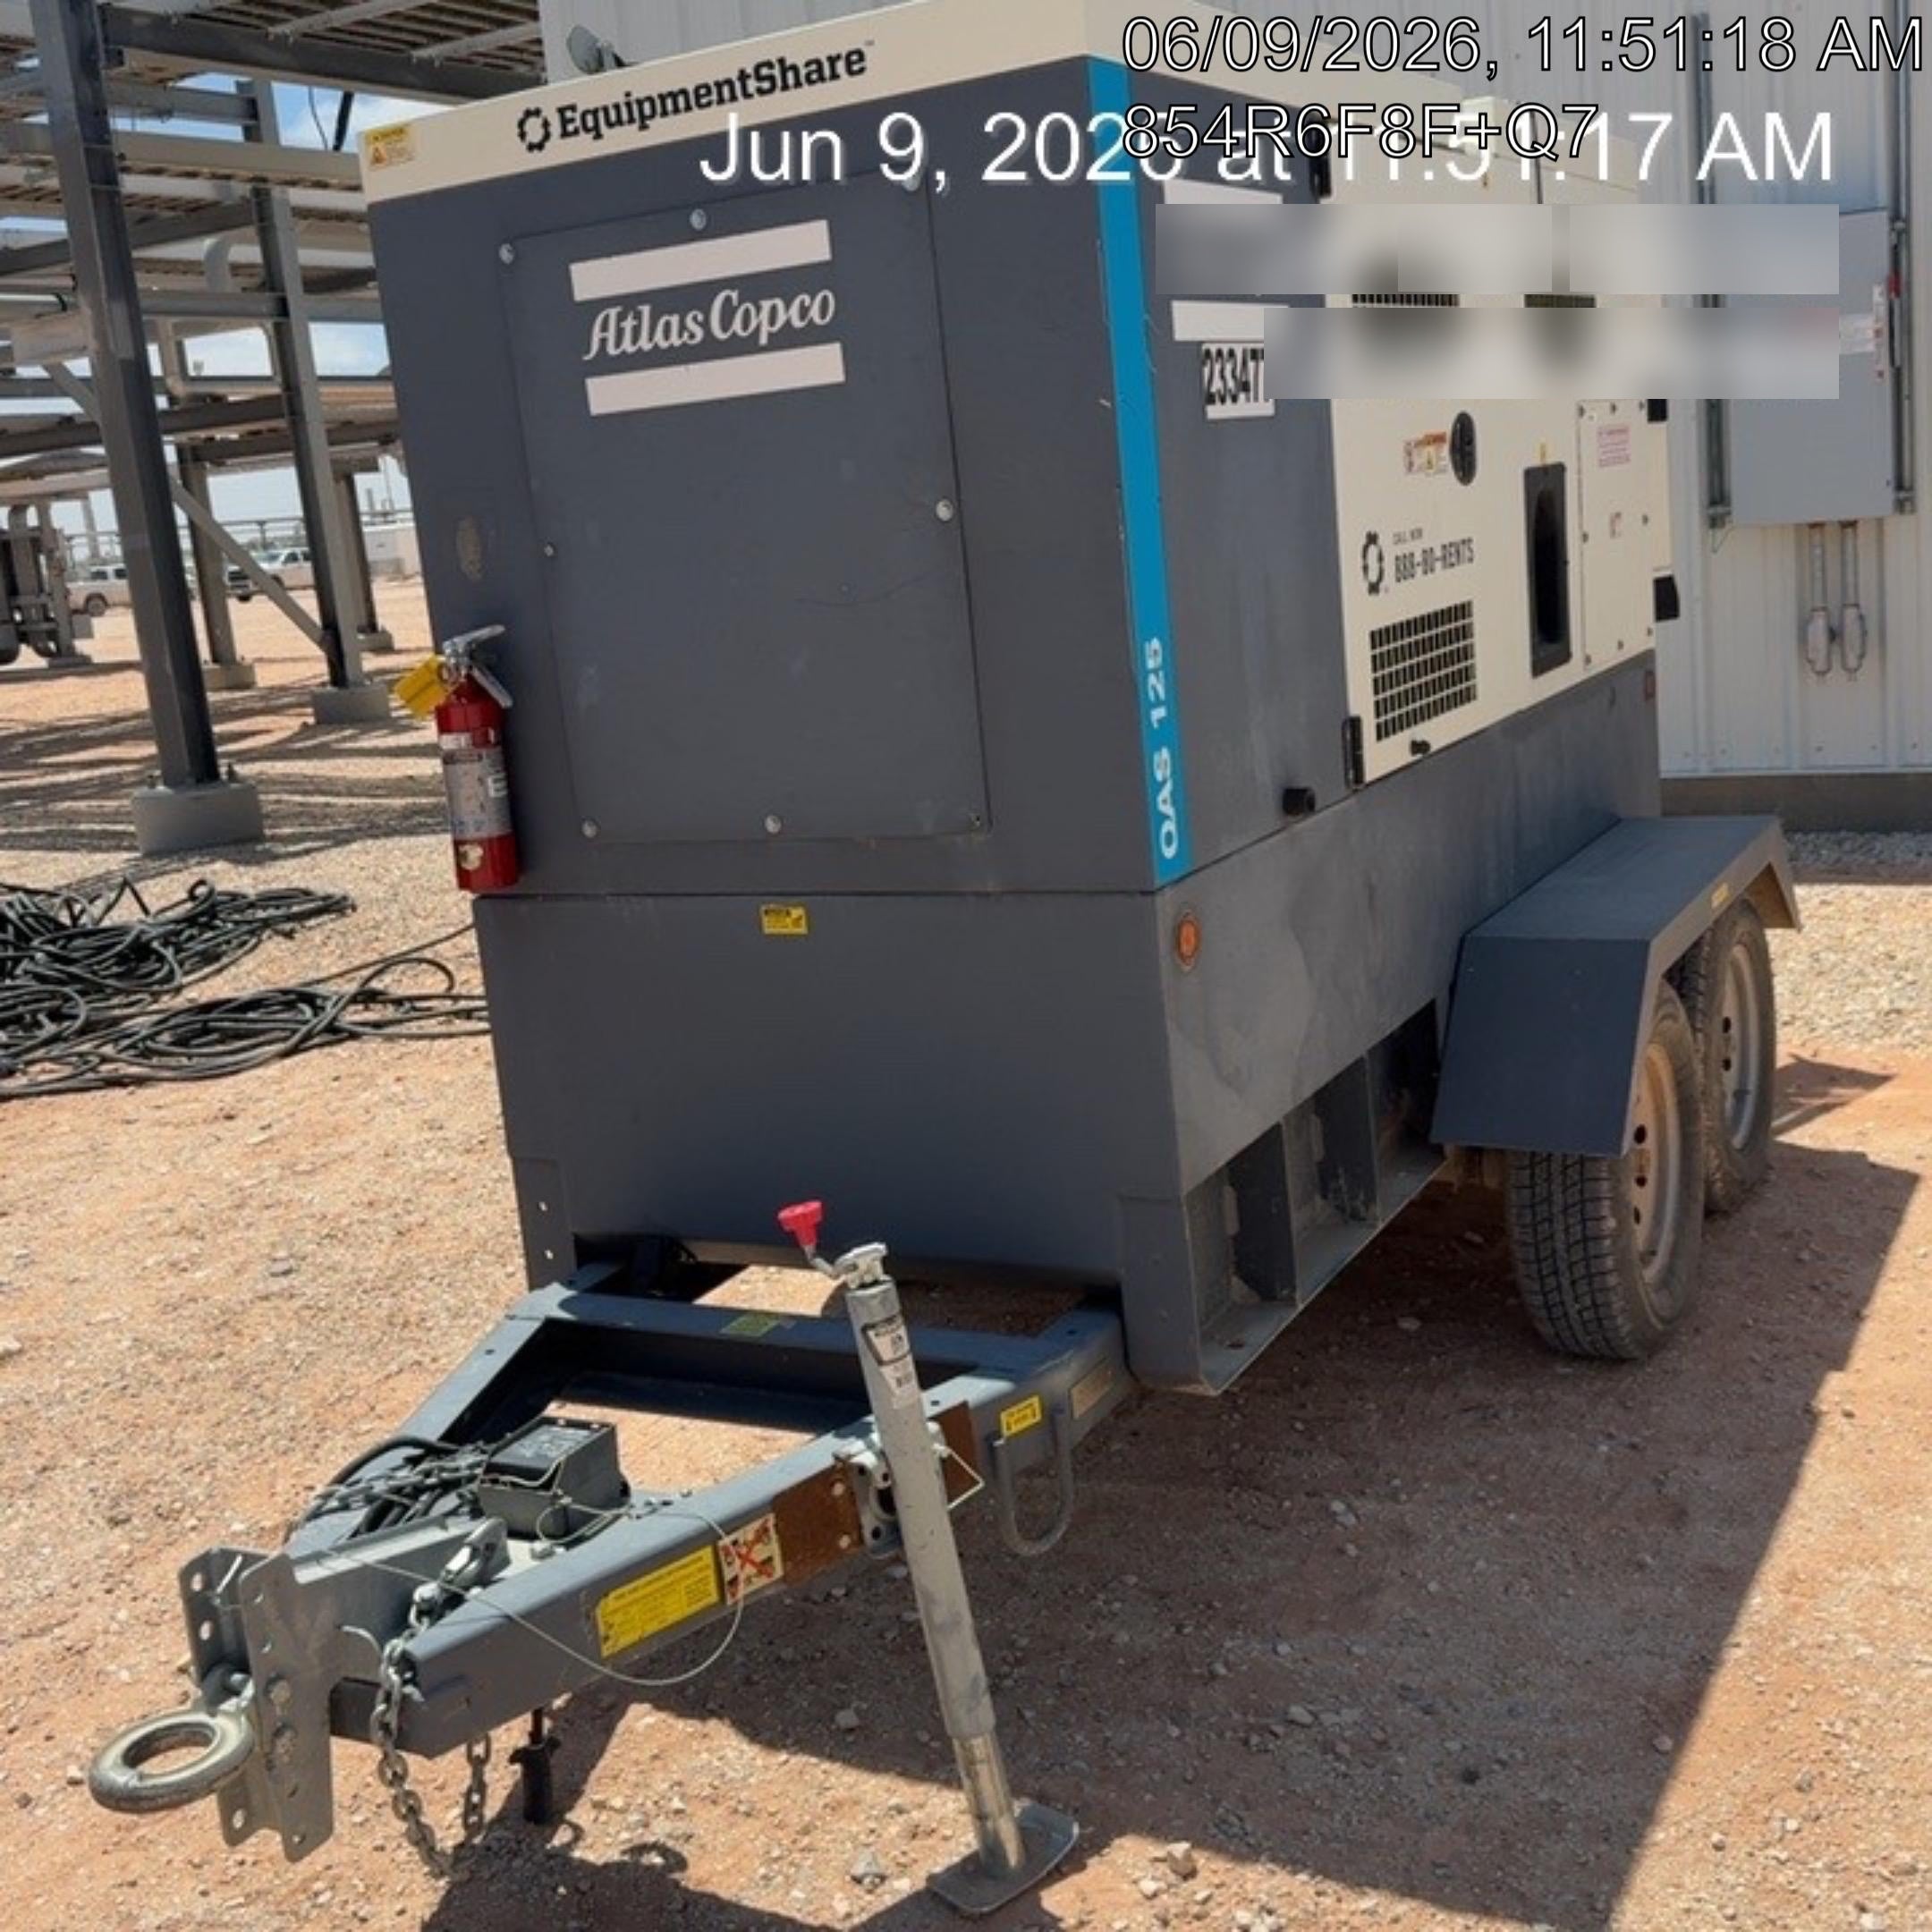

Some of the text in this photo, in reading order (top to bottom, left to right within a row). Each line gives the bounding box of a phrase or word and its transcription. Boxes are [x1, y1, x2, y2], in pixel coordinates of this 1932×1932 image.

[555, 46, 868, 141] EquipmentShare
[582, 288, 836, 361] Atlas Copco
[1201, 347, 1269, 406] 23347
